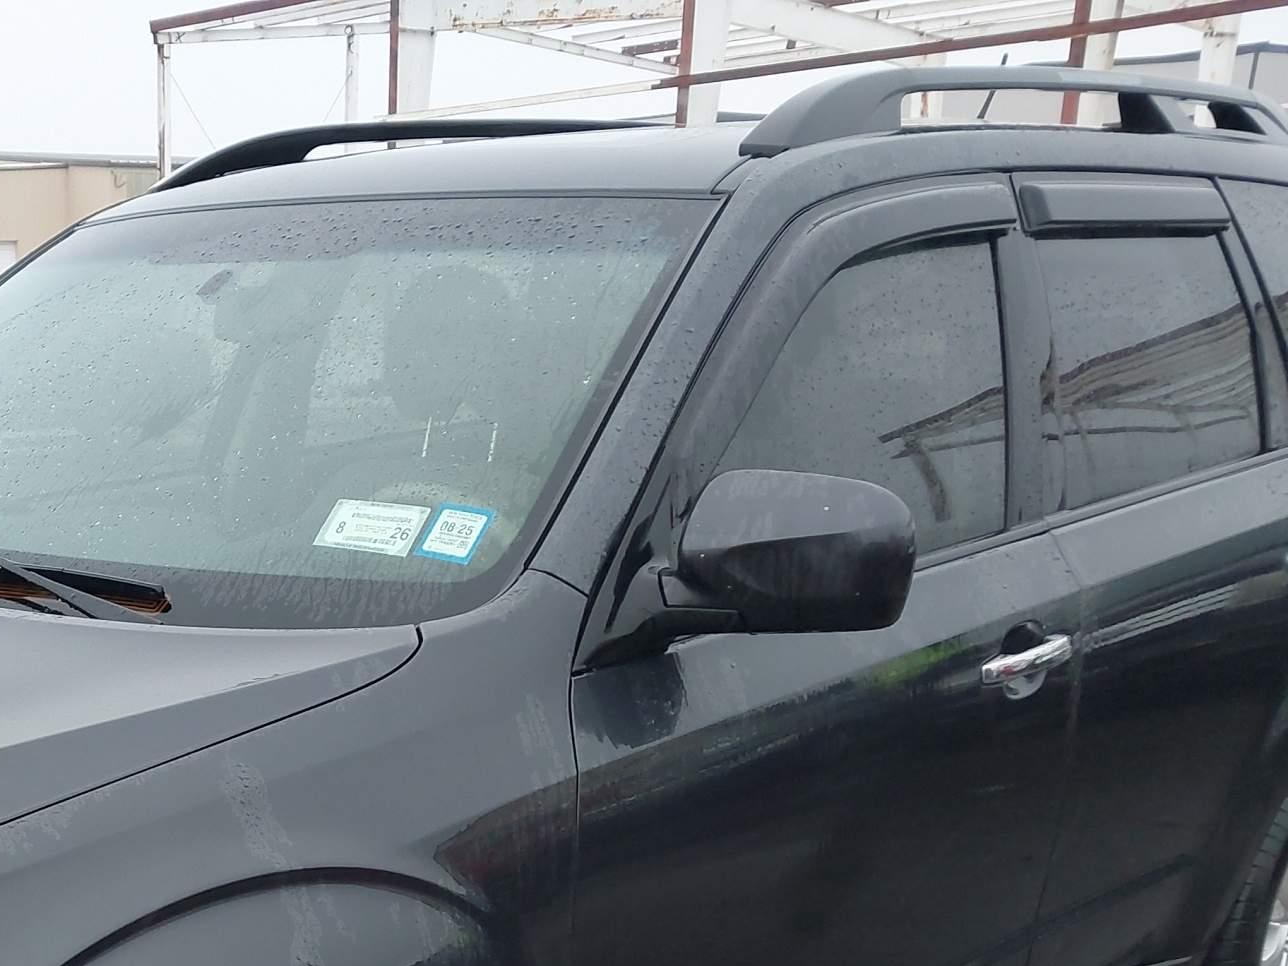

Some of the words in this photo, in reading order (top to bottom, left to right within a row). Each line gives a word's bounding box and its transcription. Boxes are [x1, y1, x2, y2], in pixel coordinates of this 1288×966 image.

[335, 521, 347, 534] 8
[389, 526, 412, 541] 26
[457, 523, 475, 536] 25
